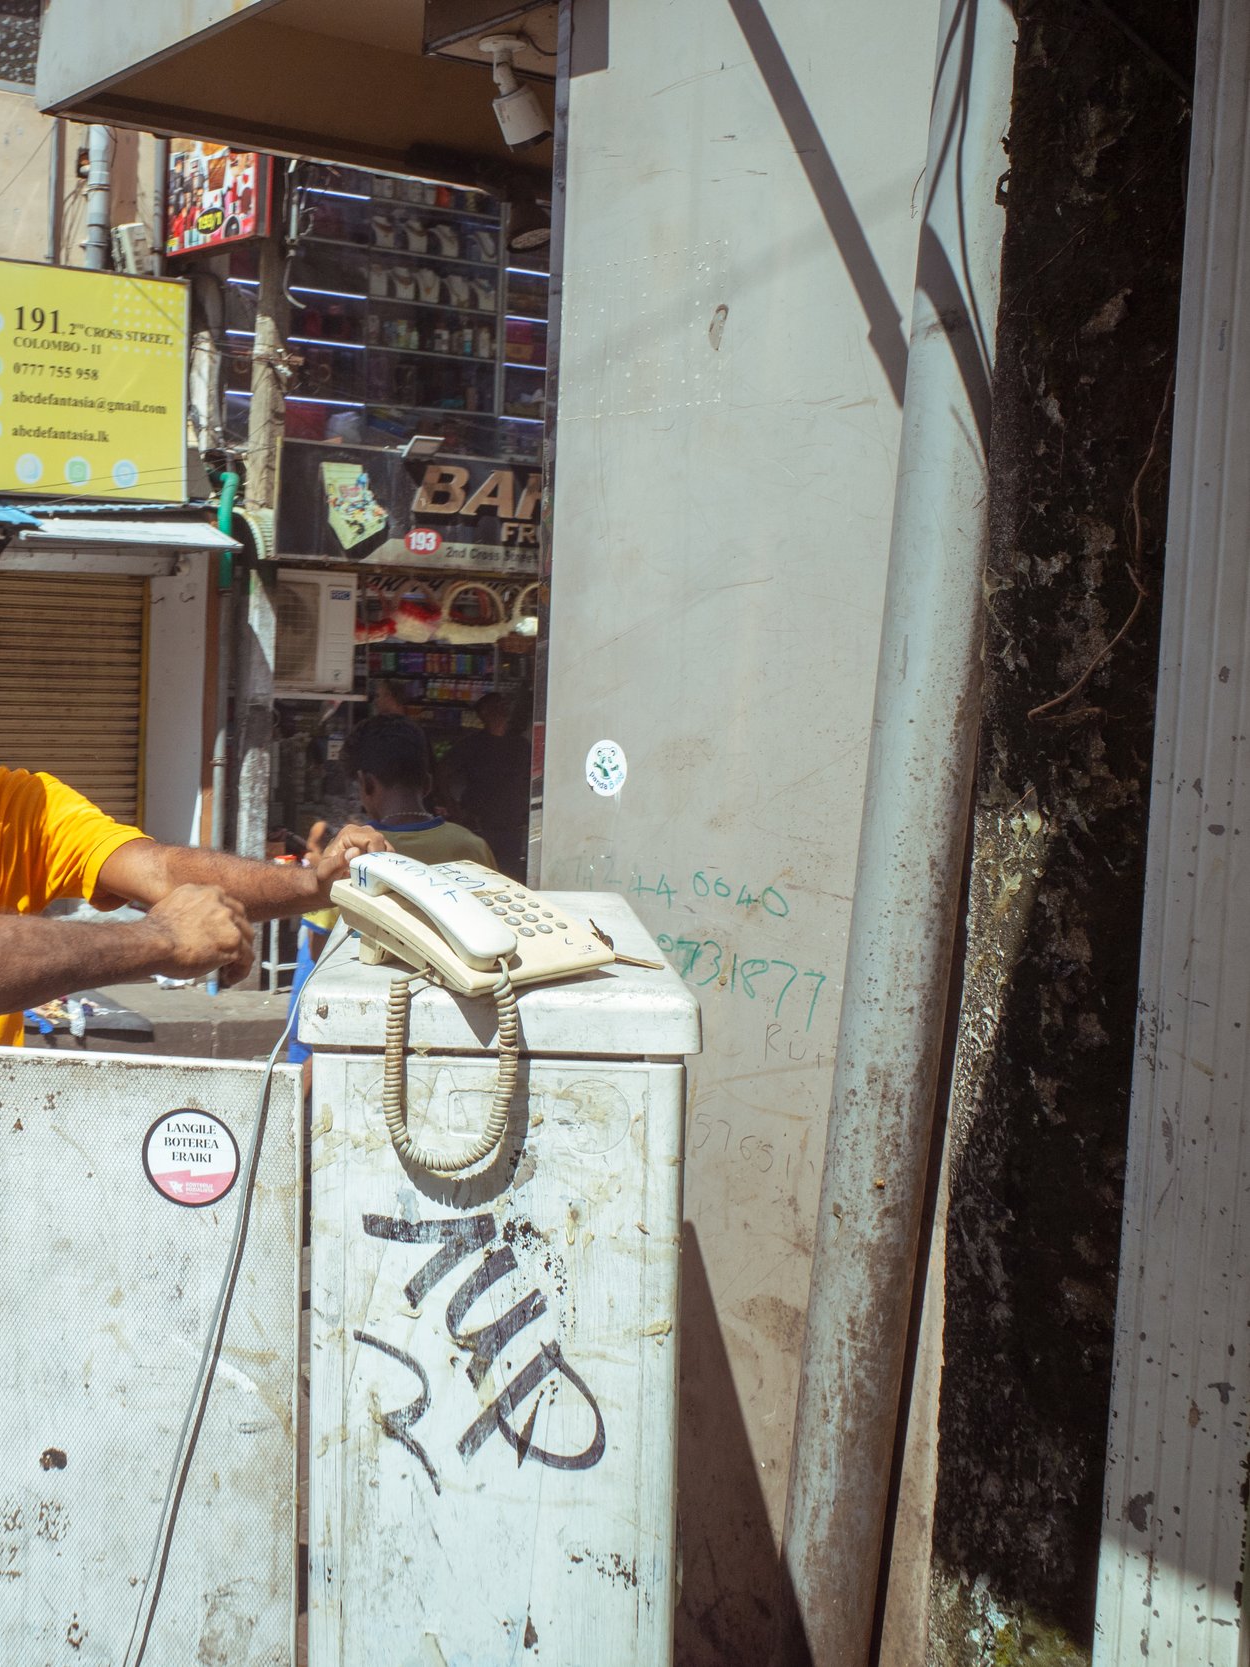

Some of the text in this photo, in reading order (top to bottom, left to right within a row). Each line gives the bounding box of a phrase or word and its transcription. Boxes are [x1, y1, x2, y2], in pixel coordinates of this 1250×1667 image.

[84, 326, 123, 341] CROSS
[13, 336, 81, 353] COLOMBO
[13, 362, 99, 381] 0777 755 958
[12, 391, 167, 415] abcdefantasia@gmail.com
[12, 425, 110, 443] abcdefantasia.lk
[409, 531, 437, 551] 193
[445, 546, 466, 558] 2nd
[470, 548, 500, 561] Cross
[166, 1122, 216, 1135] LANGILE
[164, 1136, 219, 1149] BOTEREA
[172, 1151, 211, 1163] ERAIKI
